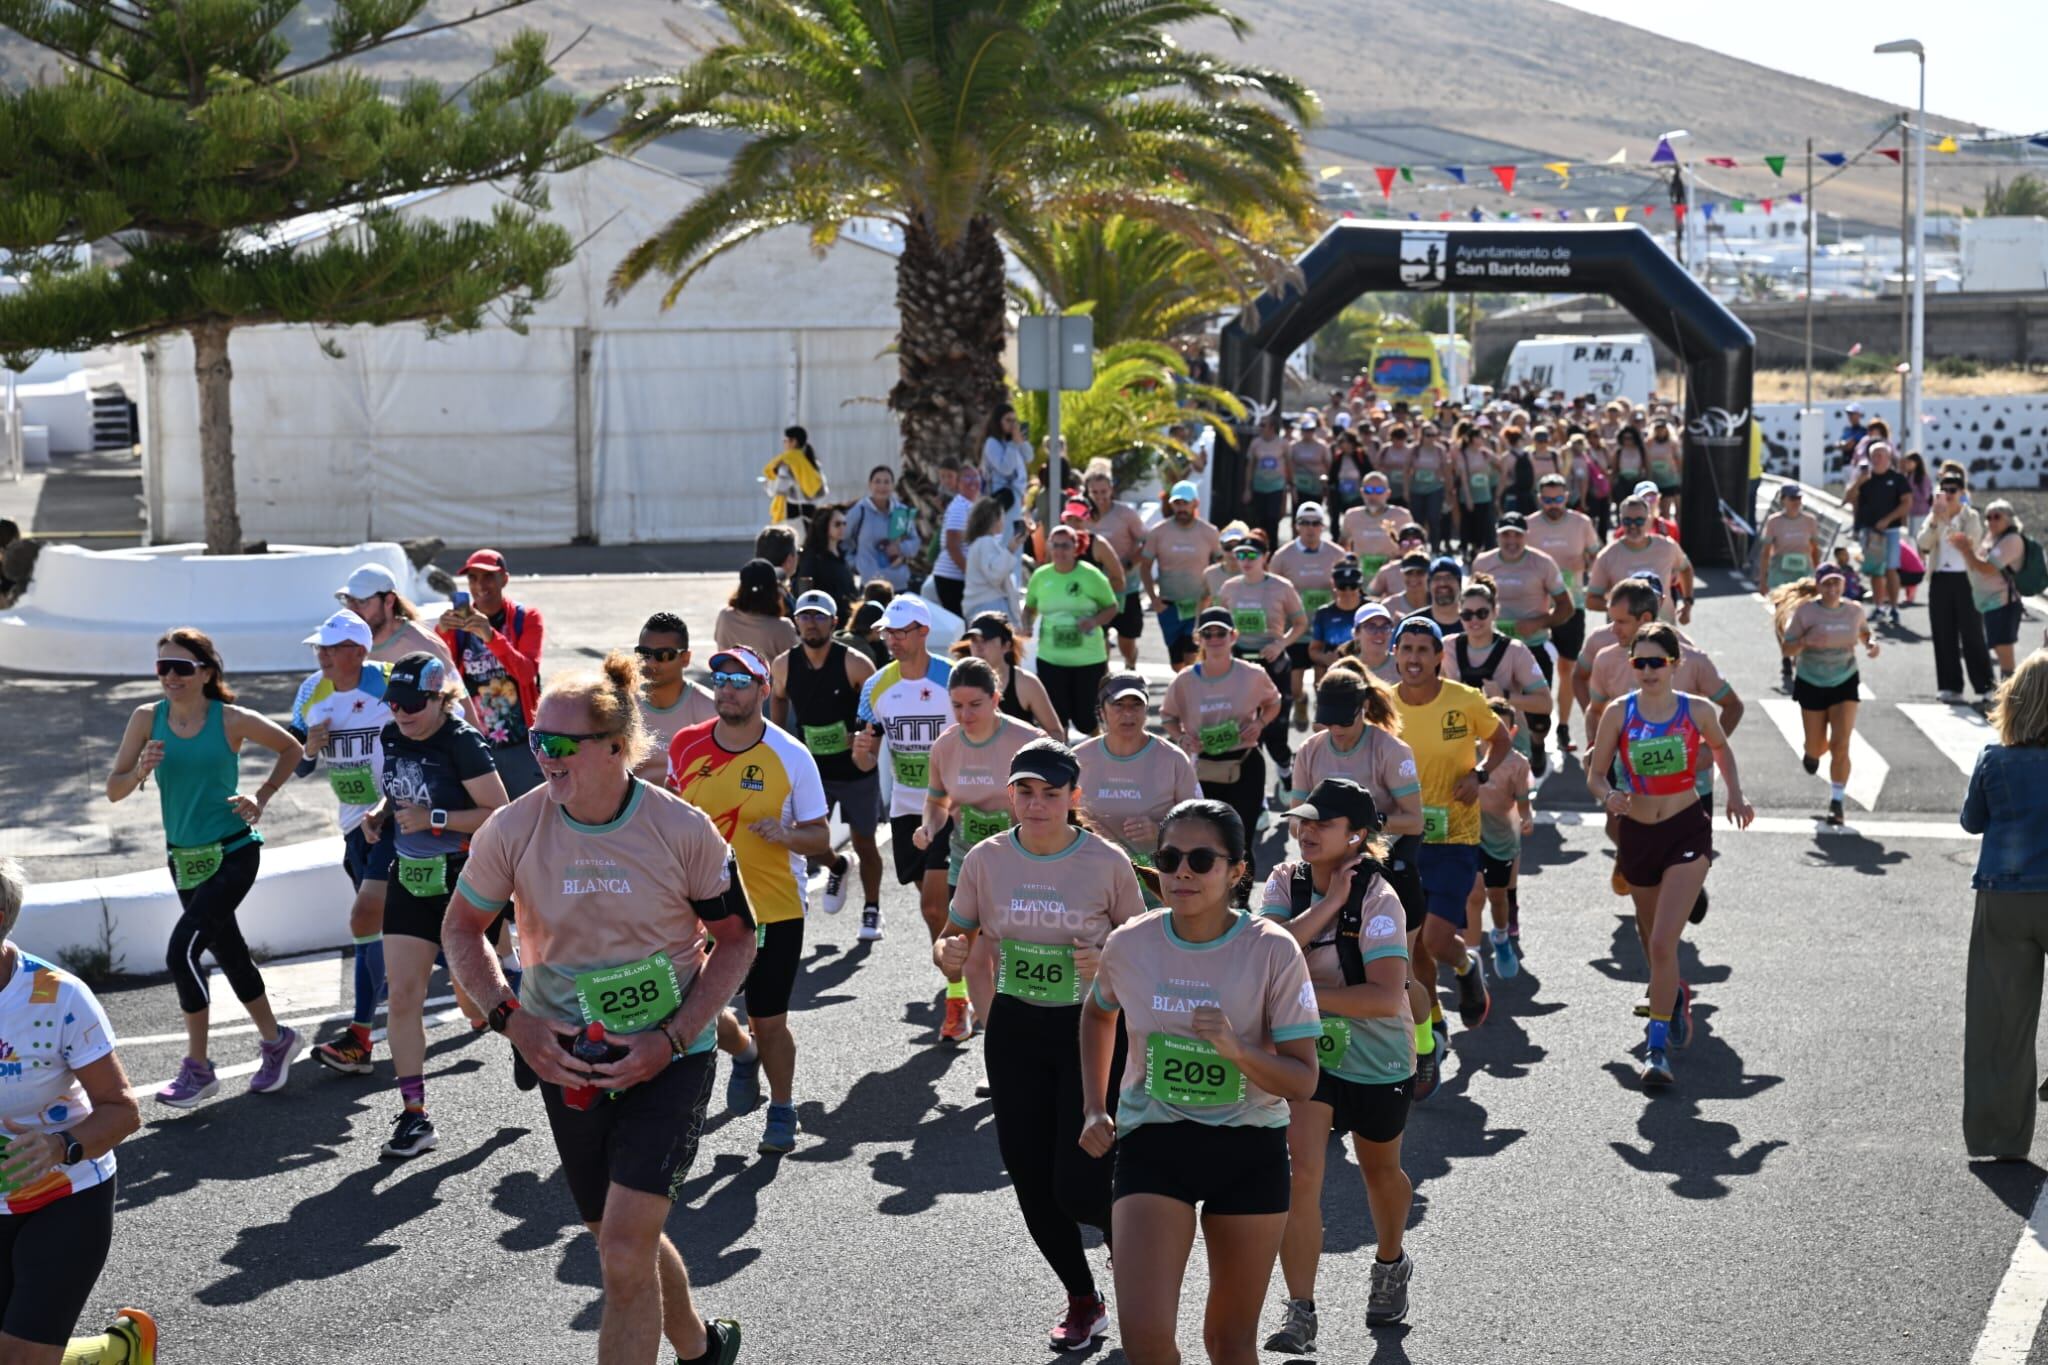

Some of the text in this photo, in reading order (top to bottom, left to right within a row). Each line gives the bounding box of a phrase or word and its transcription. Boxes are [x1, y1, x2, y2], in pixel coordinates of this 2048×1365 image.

[1455, 245, 1571, 261] Ayuntamiento de
[1455, 261, 1571, 277] San Bartolomé
[813, 734, 840, 746] 252
[1205, 731, 1234, 746] 245
[1642, 748, 1675, 767] 214
[901, 764, 925, 777] 217
[338, 780, 366, 794] 218
[1098, 789, 1142, 799] BLANCA
[969, 820, 1000, 836] 256
[405, 867, 433, 883] 267
[562, 878, 632, 895] BLANCA
[1010, 899, 1068, 913] BLANCA
[592, 963, 652, 984] Montaña BLANCA
[996, 948, 1007, 993] VERTICAL
[1015, 959, 1063, 984] 246
[667, 964, 682, 1007] VERTICA
[600, 979, 660, 1015] 238
[577, 989, 593, 1025] TICAL
[1164, 1040, 1219, 1056] Montaña BLAN
[1316, 1034, 1335, 1053] 0
[1163, 1058, 1226, 1086] 209
